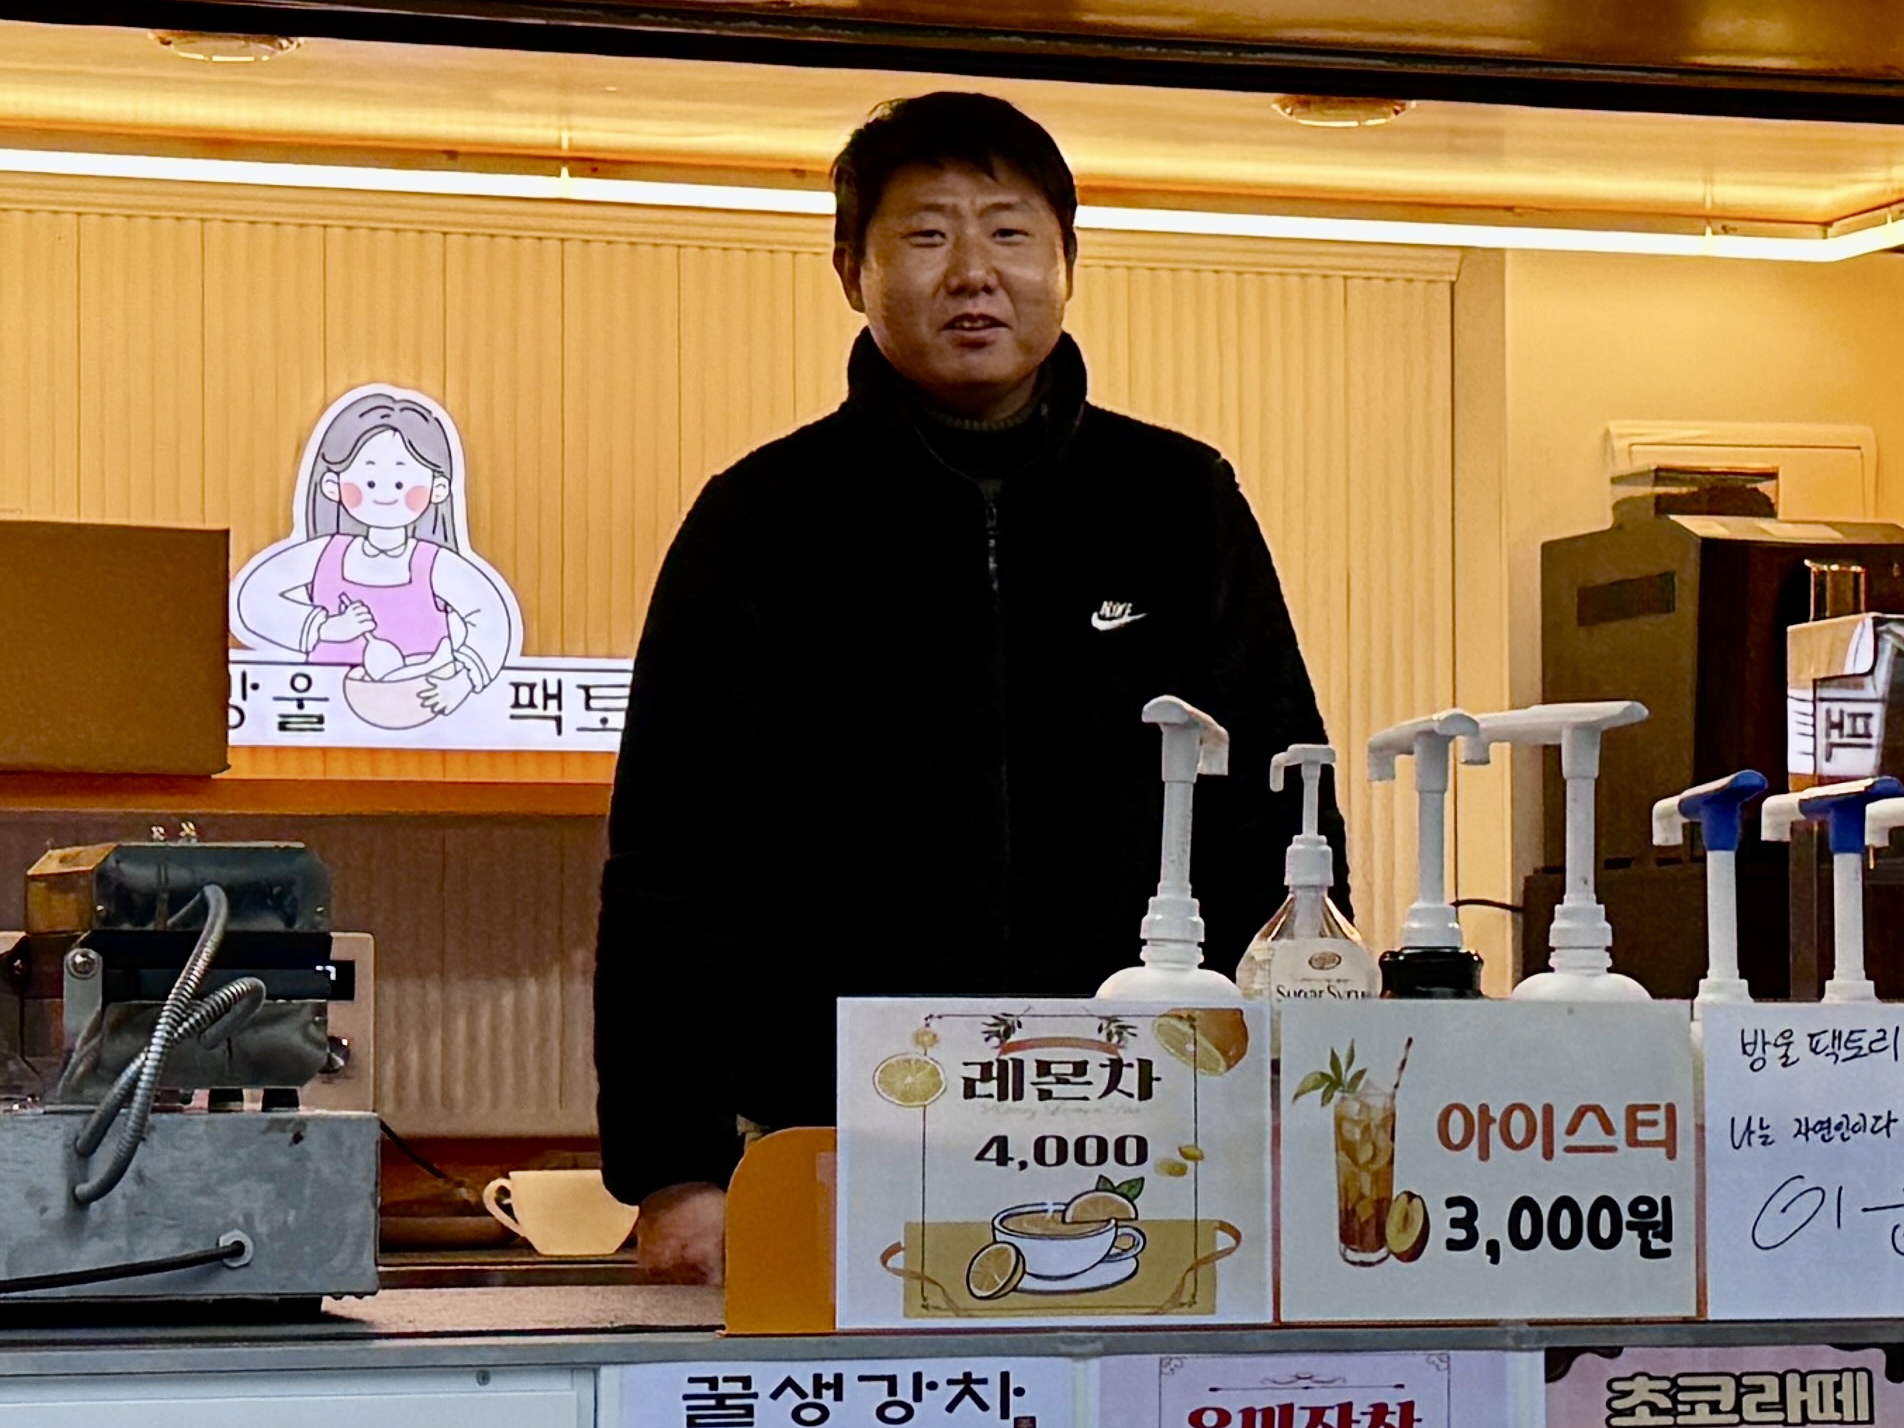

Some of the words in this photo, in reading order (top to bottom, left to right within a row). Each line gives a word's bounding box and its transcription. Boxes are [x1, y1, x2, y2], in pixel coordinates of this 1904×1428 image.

[961, 1057, 1163, 1102] 레몬차
[974, 1133, 1149, 1172] 4,000
[1436, 1101, 1678, 1162] 아이스티
[1730, 1115, 1775, 1150] 나는
[1793, 1109, 1899, 1143] 자연인이다
[1443, 1193, 1675, 1266] 3,000원
[681, 1371, 1026, 1428] 꿀생강차
